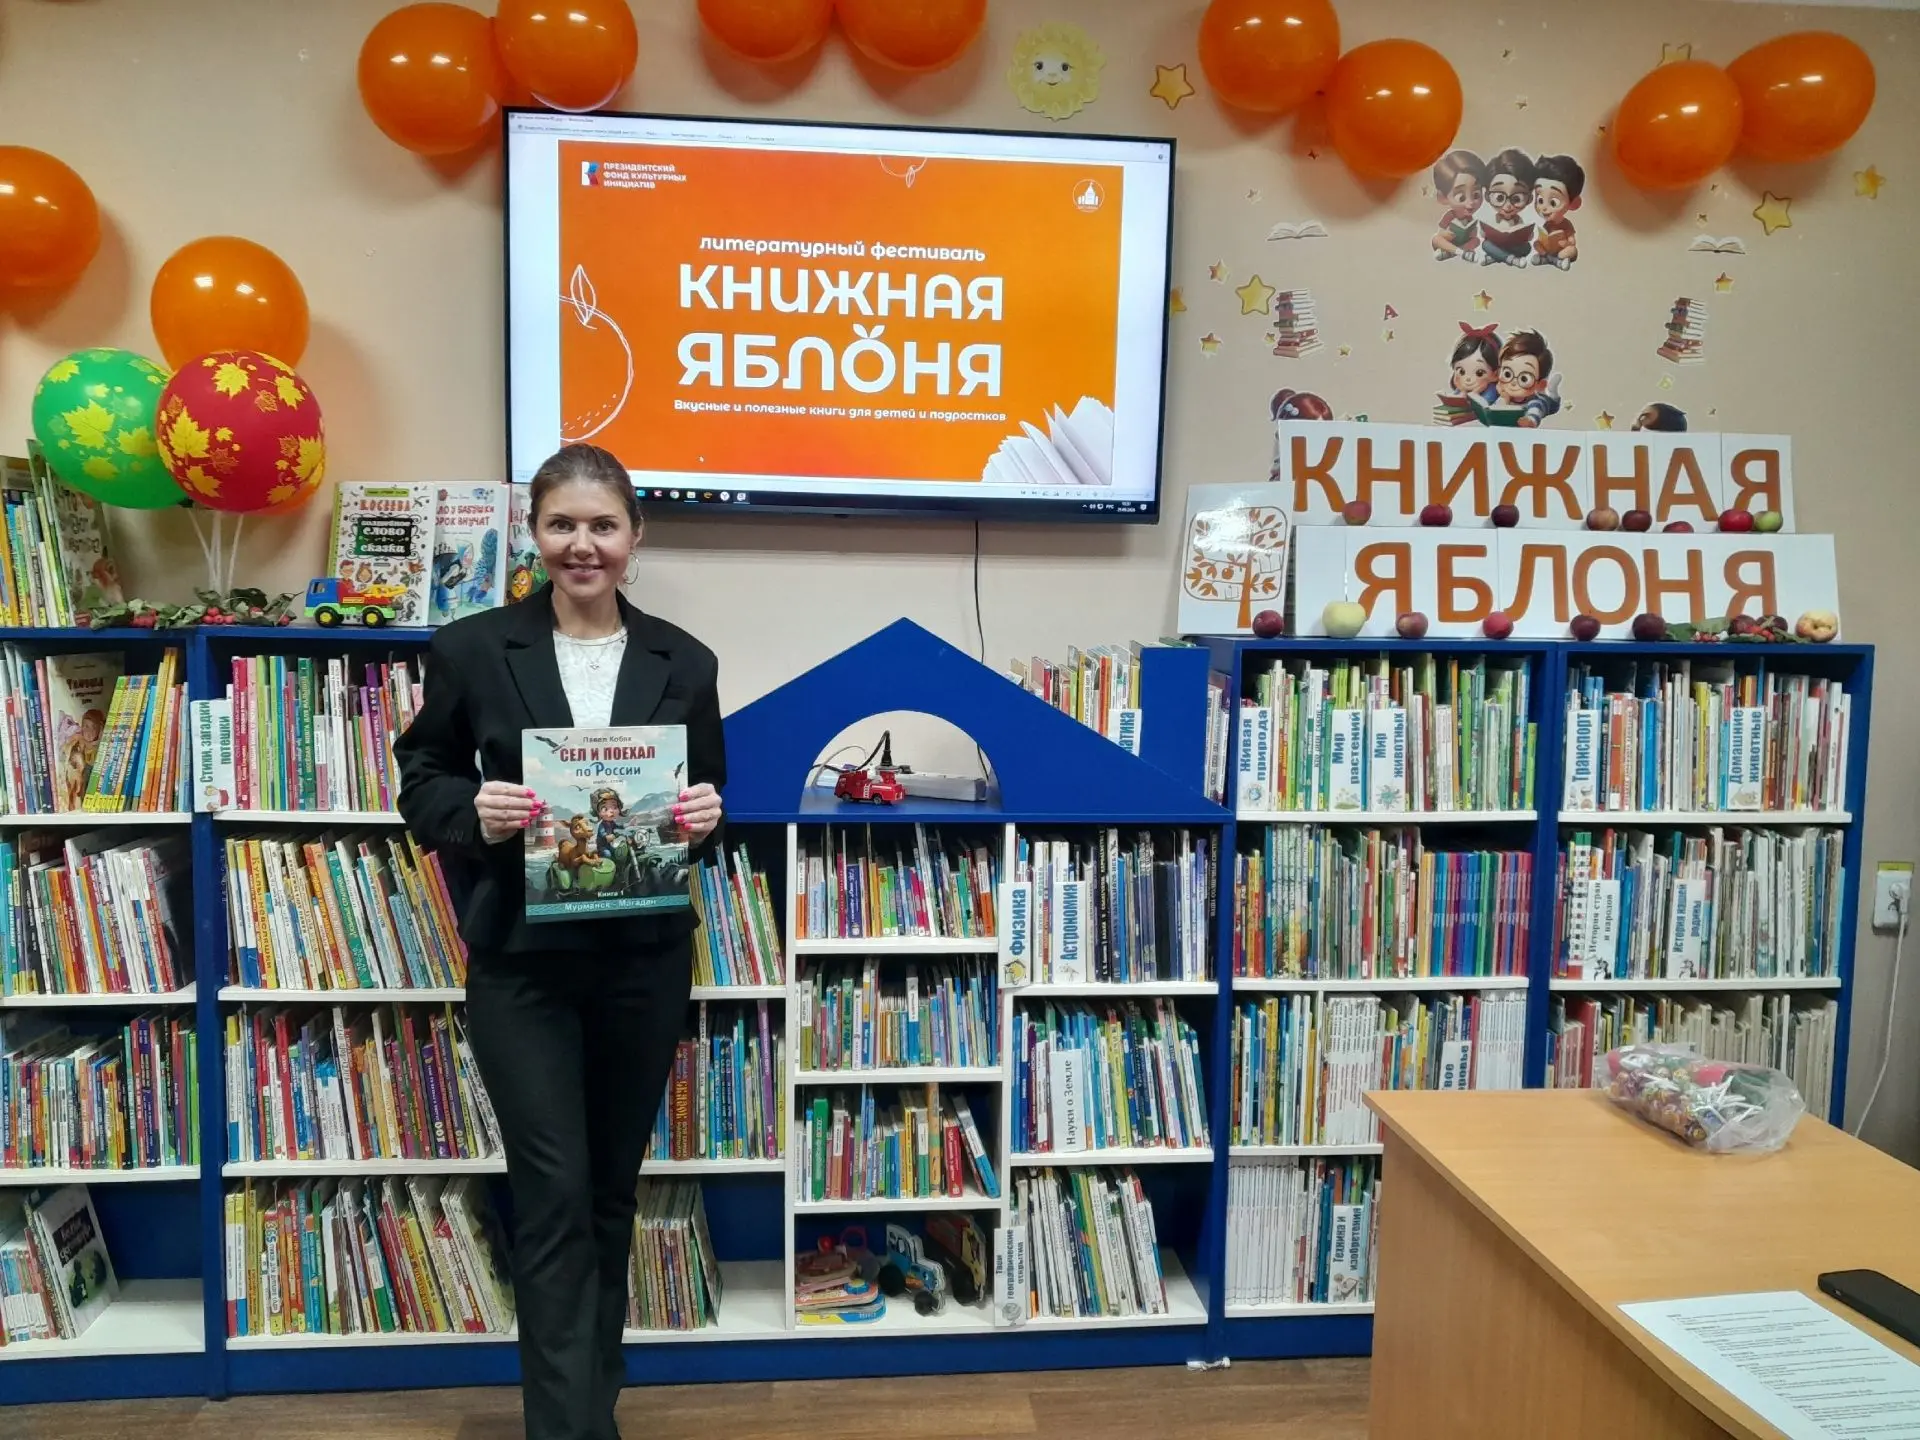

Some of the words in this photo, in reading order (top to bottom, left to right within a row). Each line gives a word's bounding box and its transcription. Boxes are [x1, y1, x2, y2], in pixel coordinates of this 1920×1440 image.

[603, 162, 675, 172] ПРЕЗИДЕНТСКИЙ
[603, 171, 629, 180] ФОНД
[631, 172, 687, 182] КУЛЬТУРНЫХ
[603, 179, 655, 189] ИНИЦИАТИВ
[699, 236, 865, 257] литературный
[870, 242, 985, 261] фестиваль
[679, 263, 1003, 321] КНИЖНАЯ
[677, 328, 1002, 397] ЯБЛОНЯ
[674, 399, 731, 413] Вкусные
[733, 402, 742, 412] и
[745, 402, 806, 415] полезные
[809, 405, 846, 416] книги
[849, 406, 872, 420] для
[874, 407, 915, 420] детей
[918, 410, 927, 419] и
[929, 409, 1006, 423] подростков
[1291, 436, 1781, 521] КНИЖНАЯ
[457, 505, 495, 514] БАБУШКИ
[1353, 541, 1777, 625] ЯБЛОНЯ
[199, 702, 213, 744] загадки
[218, 716, 231, 764] потешки
[560, 748, 586, 762] СЕЛ
[591, 748, 599, 761] И
[603, 745, 656, 761] ПОЕХАЛ
[1240, 718, 1252, 772] Живая
[1257, 709, 1268, 780] природа
[1331, 733, 1345, 764] Мир
[1348, 711, 1360, 784] растений
[1374, 733, 1387, 758] Мир
[1393, 712, 1405, 778] животных
[1572, 713, 1592, 782] Транспорт
[1730, 710, 1744, 784] Домашние
[1748, 711, 1762, 782] животные
[199, 747, 213, 783] Стихи,
[576, 768, 591, 777] по
[590, 762, 641, 777] России
[565, 901, 610, 911] Мурманск
[618, 899, 657, 908] Магадан
[1593, 881, 1602, 910] стран
[1604, 894, 1613, 932] народов
[1009, 889, 1026, 956] Физика
[1060, 884, 1079, 960] Астрономия
[1589, 913, 1599, 953] История
[1673, 916, 1687, 953] История
[1063, 1060, 1073, 1097] Земле
[1443, 1063, 1454, 1090] вое
[433, 1120, 446, 1143] 100
[1064, 1109, 1077, 1145] Науки
[1334, 1224, 1345, 1262] Техника
[1349, 1208, 1361, 1271] изобретения
[1006, 1230, 1017, 1299] географические
